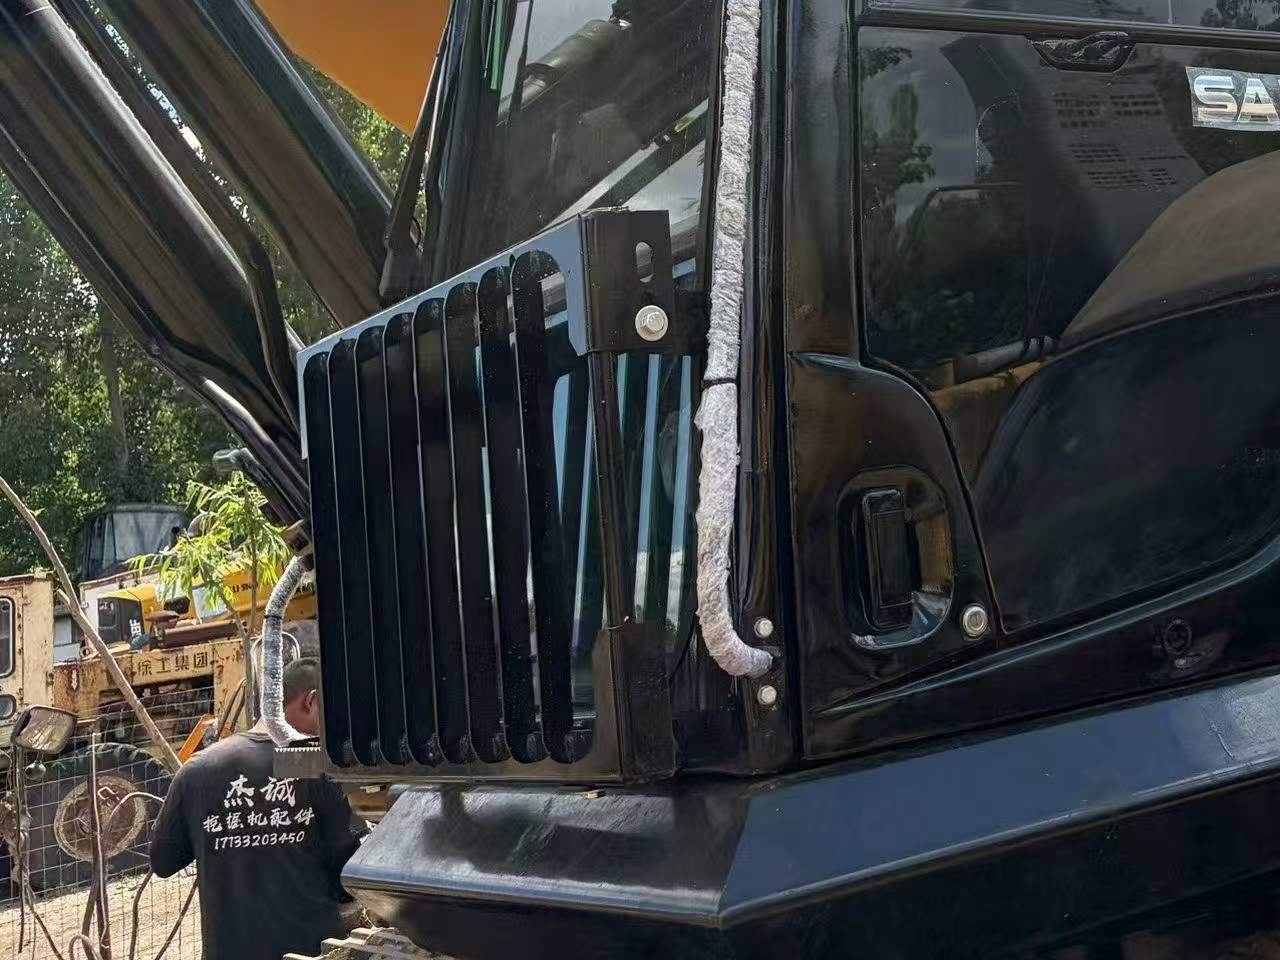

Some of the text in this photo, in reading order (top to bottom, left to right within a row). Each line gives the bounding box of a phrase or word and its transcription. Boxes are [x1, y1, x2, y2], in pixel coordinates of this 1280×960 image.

[137, 651, 208, 677] 徐工集团
[223, 774, 299, 808] 杰诚
[202, 806, 315, 833] 挖掘机配件
[214, 830, 305, 850] 17733203450
